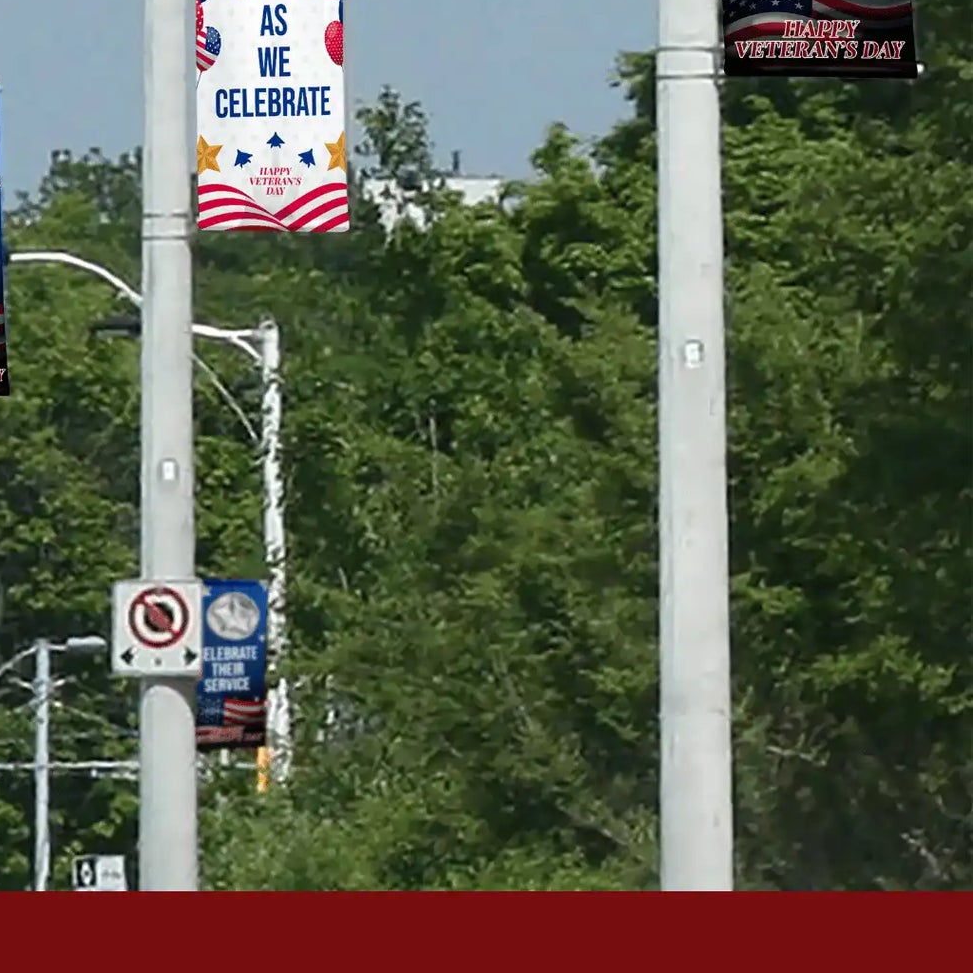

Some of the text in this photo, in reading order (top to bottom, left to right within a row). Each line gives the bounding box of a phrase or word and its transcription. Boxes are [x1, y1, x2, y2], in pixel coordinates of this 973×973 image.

[259, 3, 288, 37] AS
[782, 18, 861, 40] HAPPY
[733, 39, 906, 60] VETERAN'S DAY
[257, 45, 291, 78] WE
[215, 86, 331, 119] CELEBRATE
[258, 166, 293, 177] HAPPY
[249, 176, 302, 187] VETERAN'S
[264, 185, 287, 196] DAY
[203, 645, 258, 662] ELEBRATE
[212, 662, 245, 677] THEIR
[203, 677, 251, 693] SERVICE
